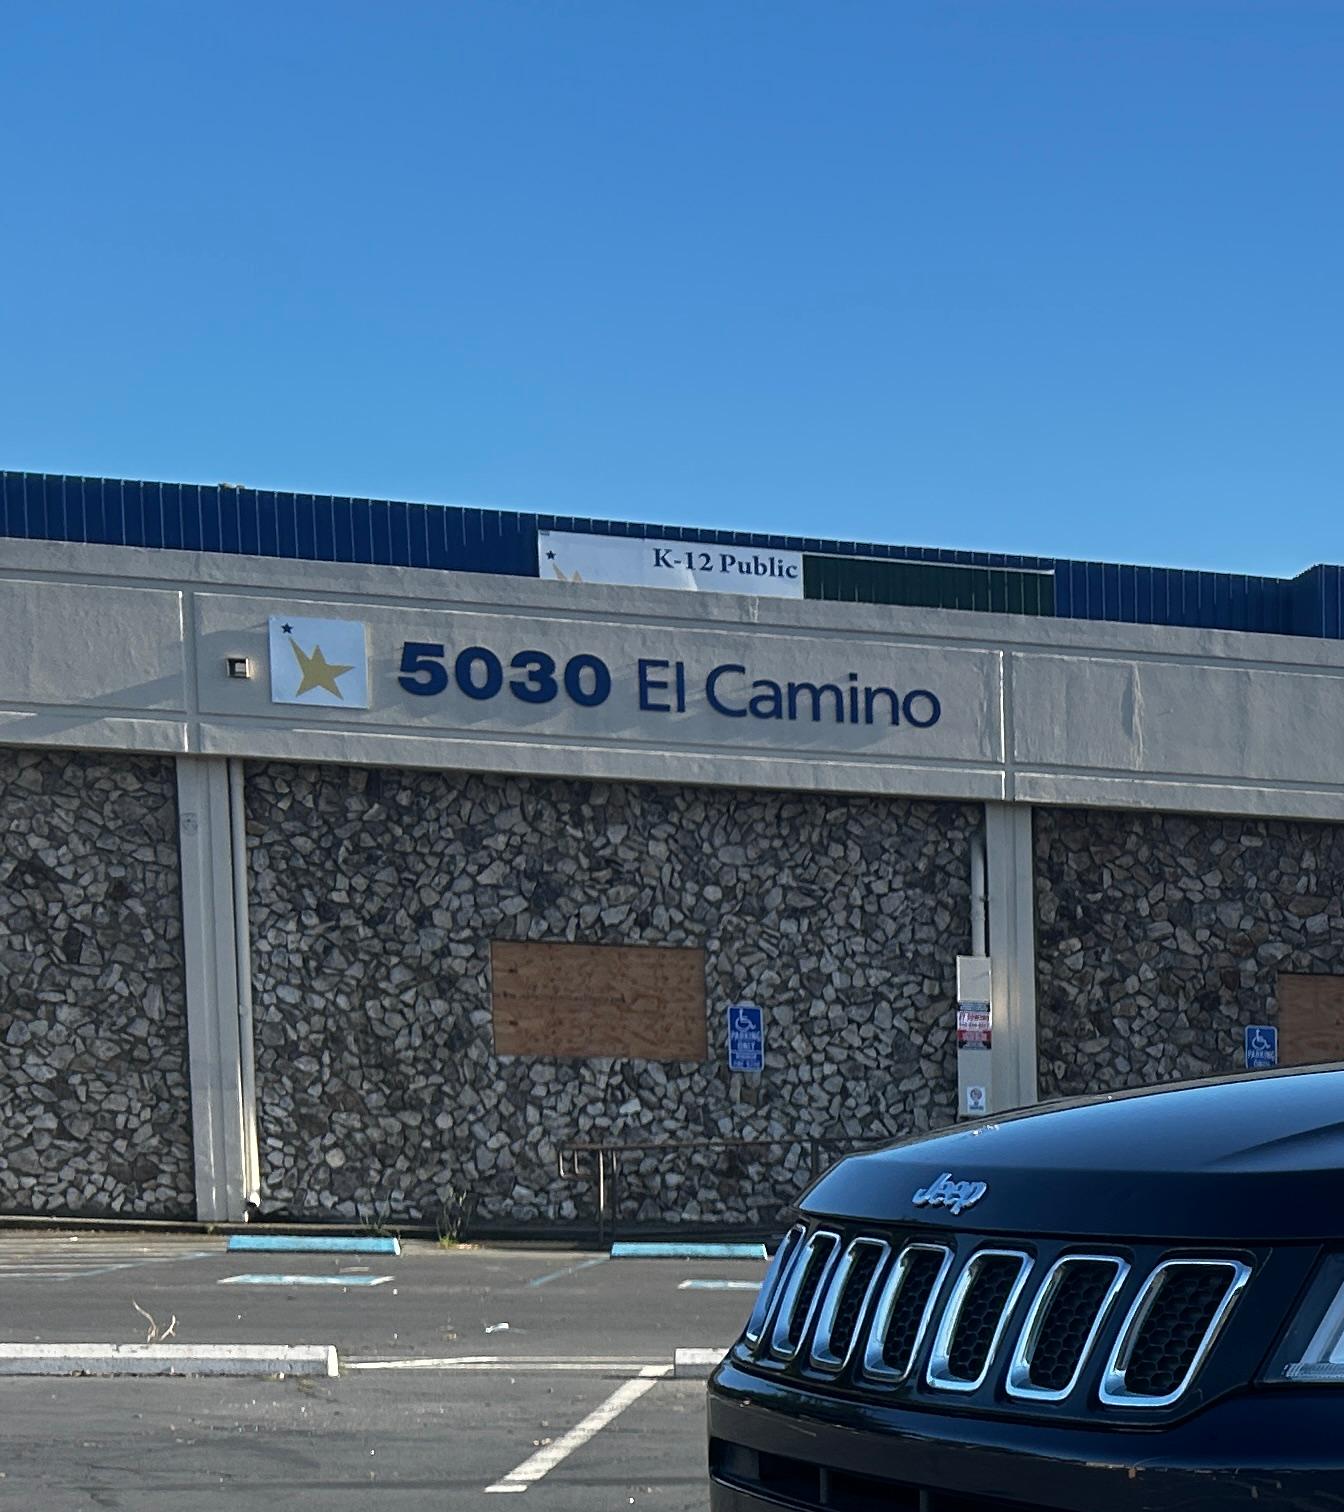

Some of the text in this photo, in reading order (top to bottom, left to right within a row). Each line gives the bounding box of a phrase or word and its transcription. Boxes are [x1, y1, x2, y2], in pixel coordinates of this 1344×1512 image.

[653, 548, 799, 579] K-12 Public
[398, 641, 942, 728] 5030 El Camino
[912, 1172, 987, 1215] Jeep
